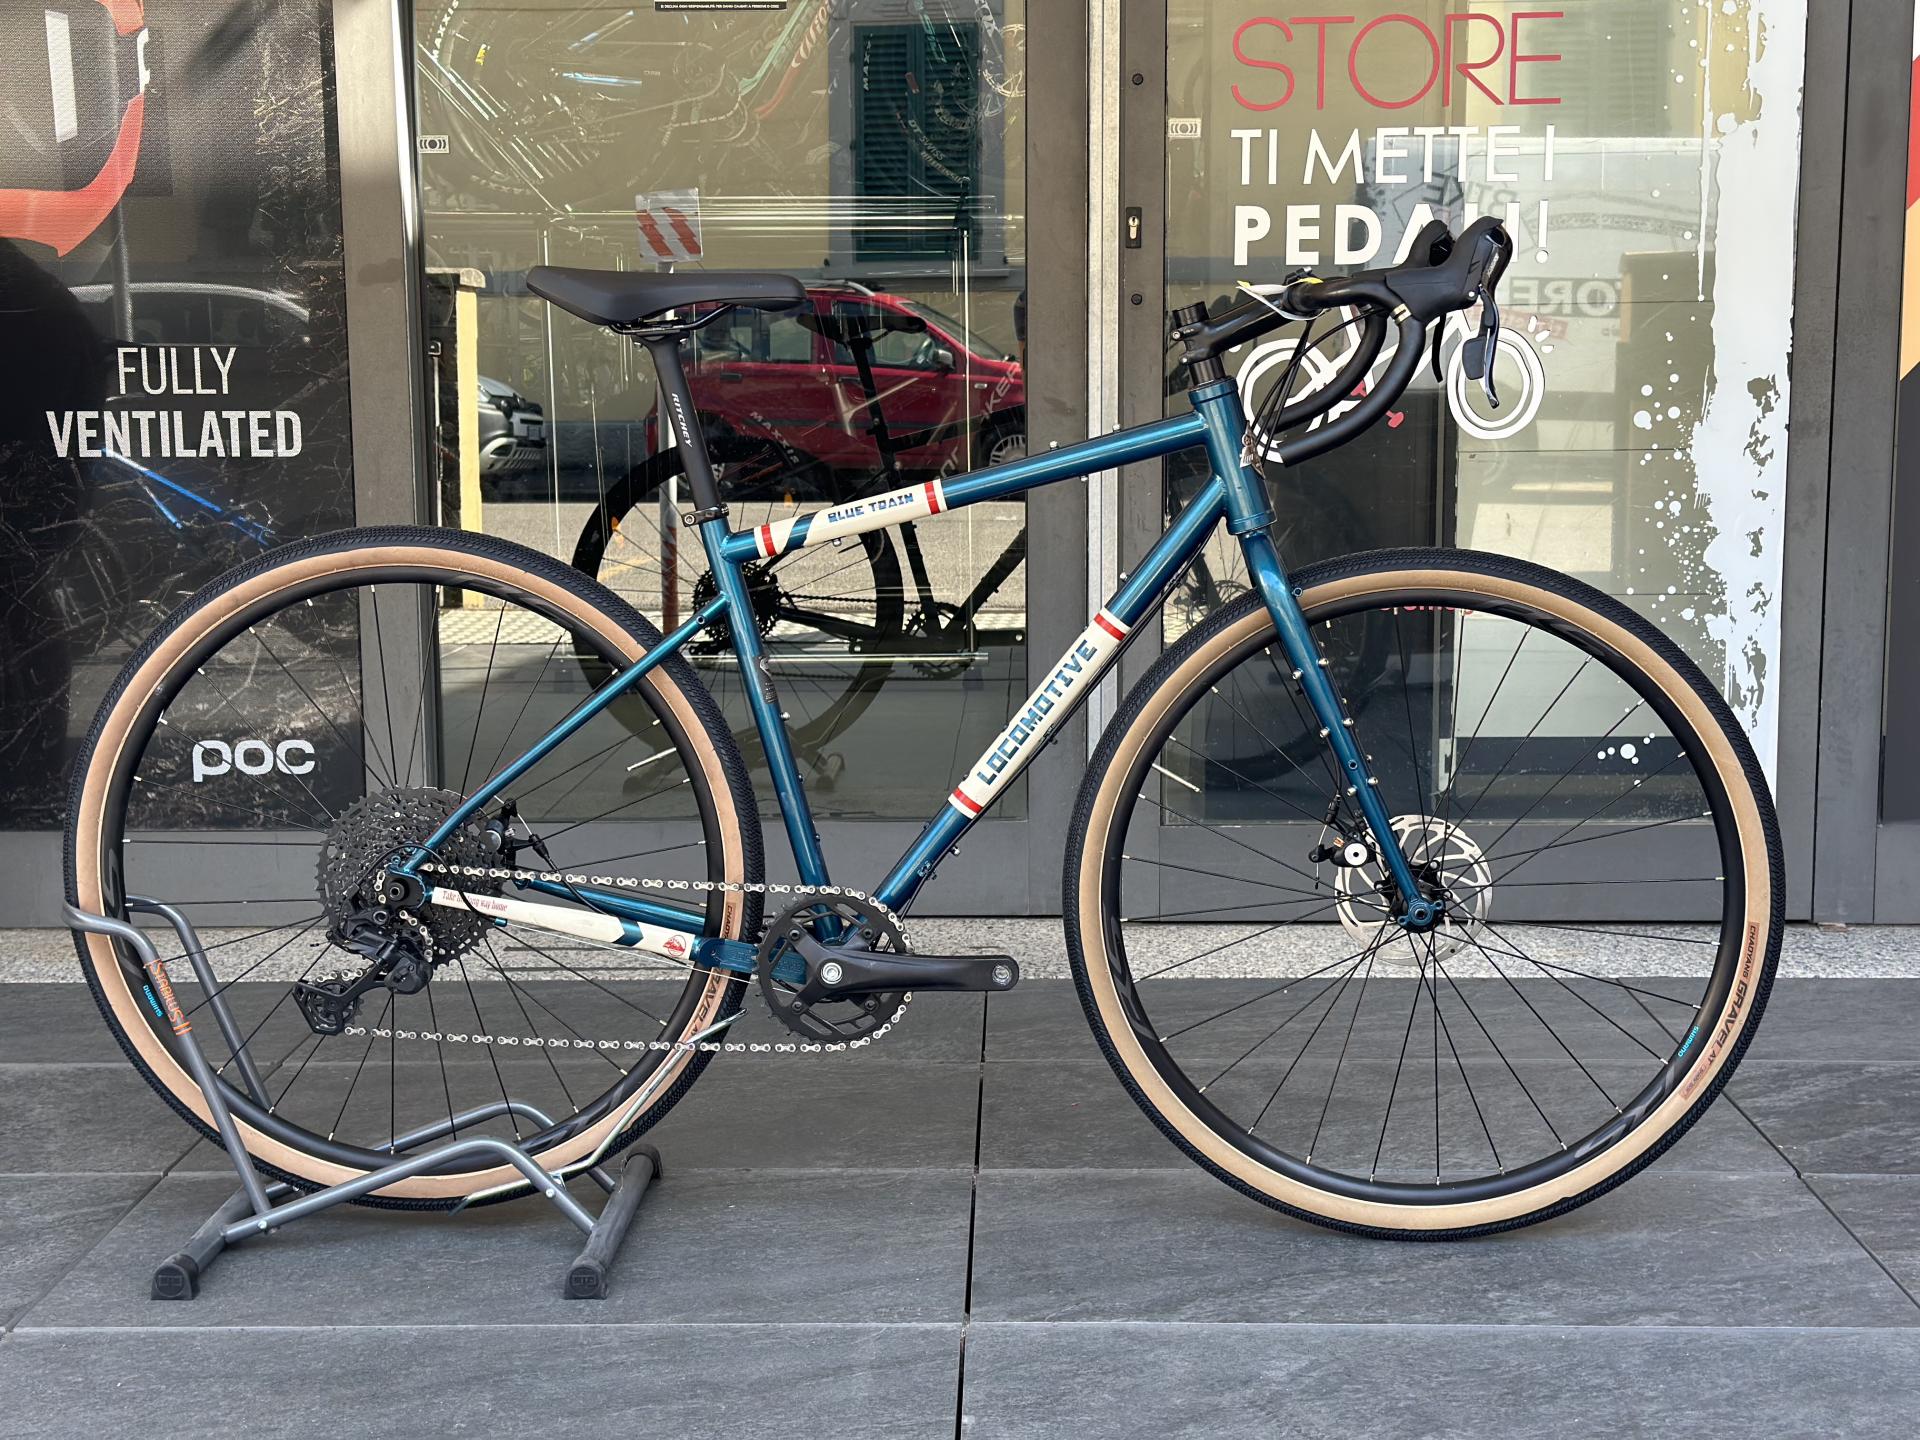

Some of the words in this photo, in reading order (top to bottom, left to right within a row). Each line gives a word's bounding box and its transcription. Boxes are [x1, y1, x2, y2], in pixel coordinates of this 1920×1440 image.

[1231, 11, 1564, 112] STORE
[919, 135, 947, 161] SWISS
[1231, 128, 1278, 186] TI
[1303, 126, 1521, 185] METTE
[1544, 124, 1555, 181] I
[116, 346, 237, 395] FULLY
[45, 410, 303, 458] VENTILATED
[671, 392, 693, 448] RITCHEY
[750, 411, 800, 464] MAXXIS
[827, 505, 865, 523] BLUE
[868, 492, 914, 512] TRAIN
[976, 639, 1098, 786] LOCOMOTIVE
[1743, 925, 1756, 978] CHAOYANG
[1715, 982, 1748, 1047] GRAVEL
[1677, 1026, 1700, 1058] SHIMANO
